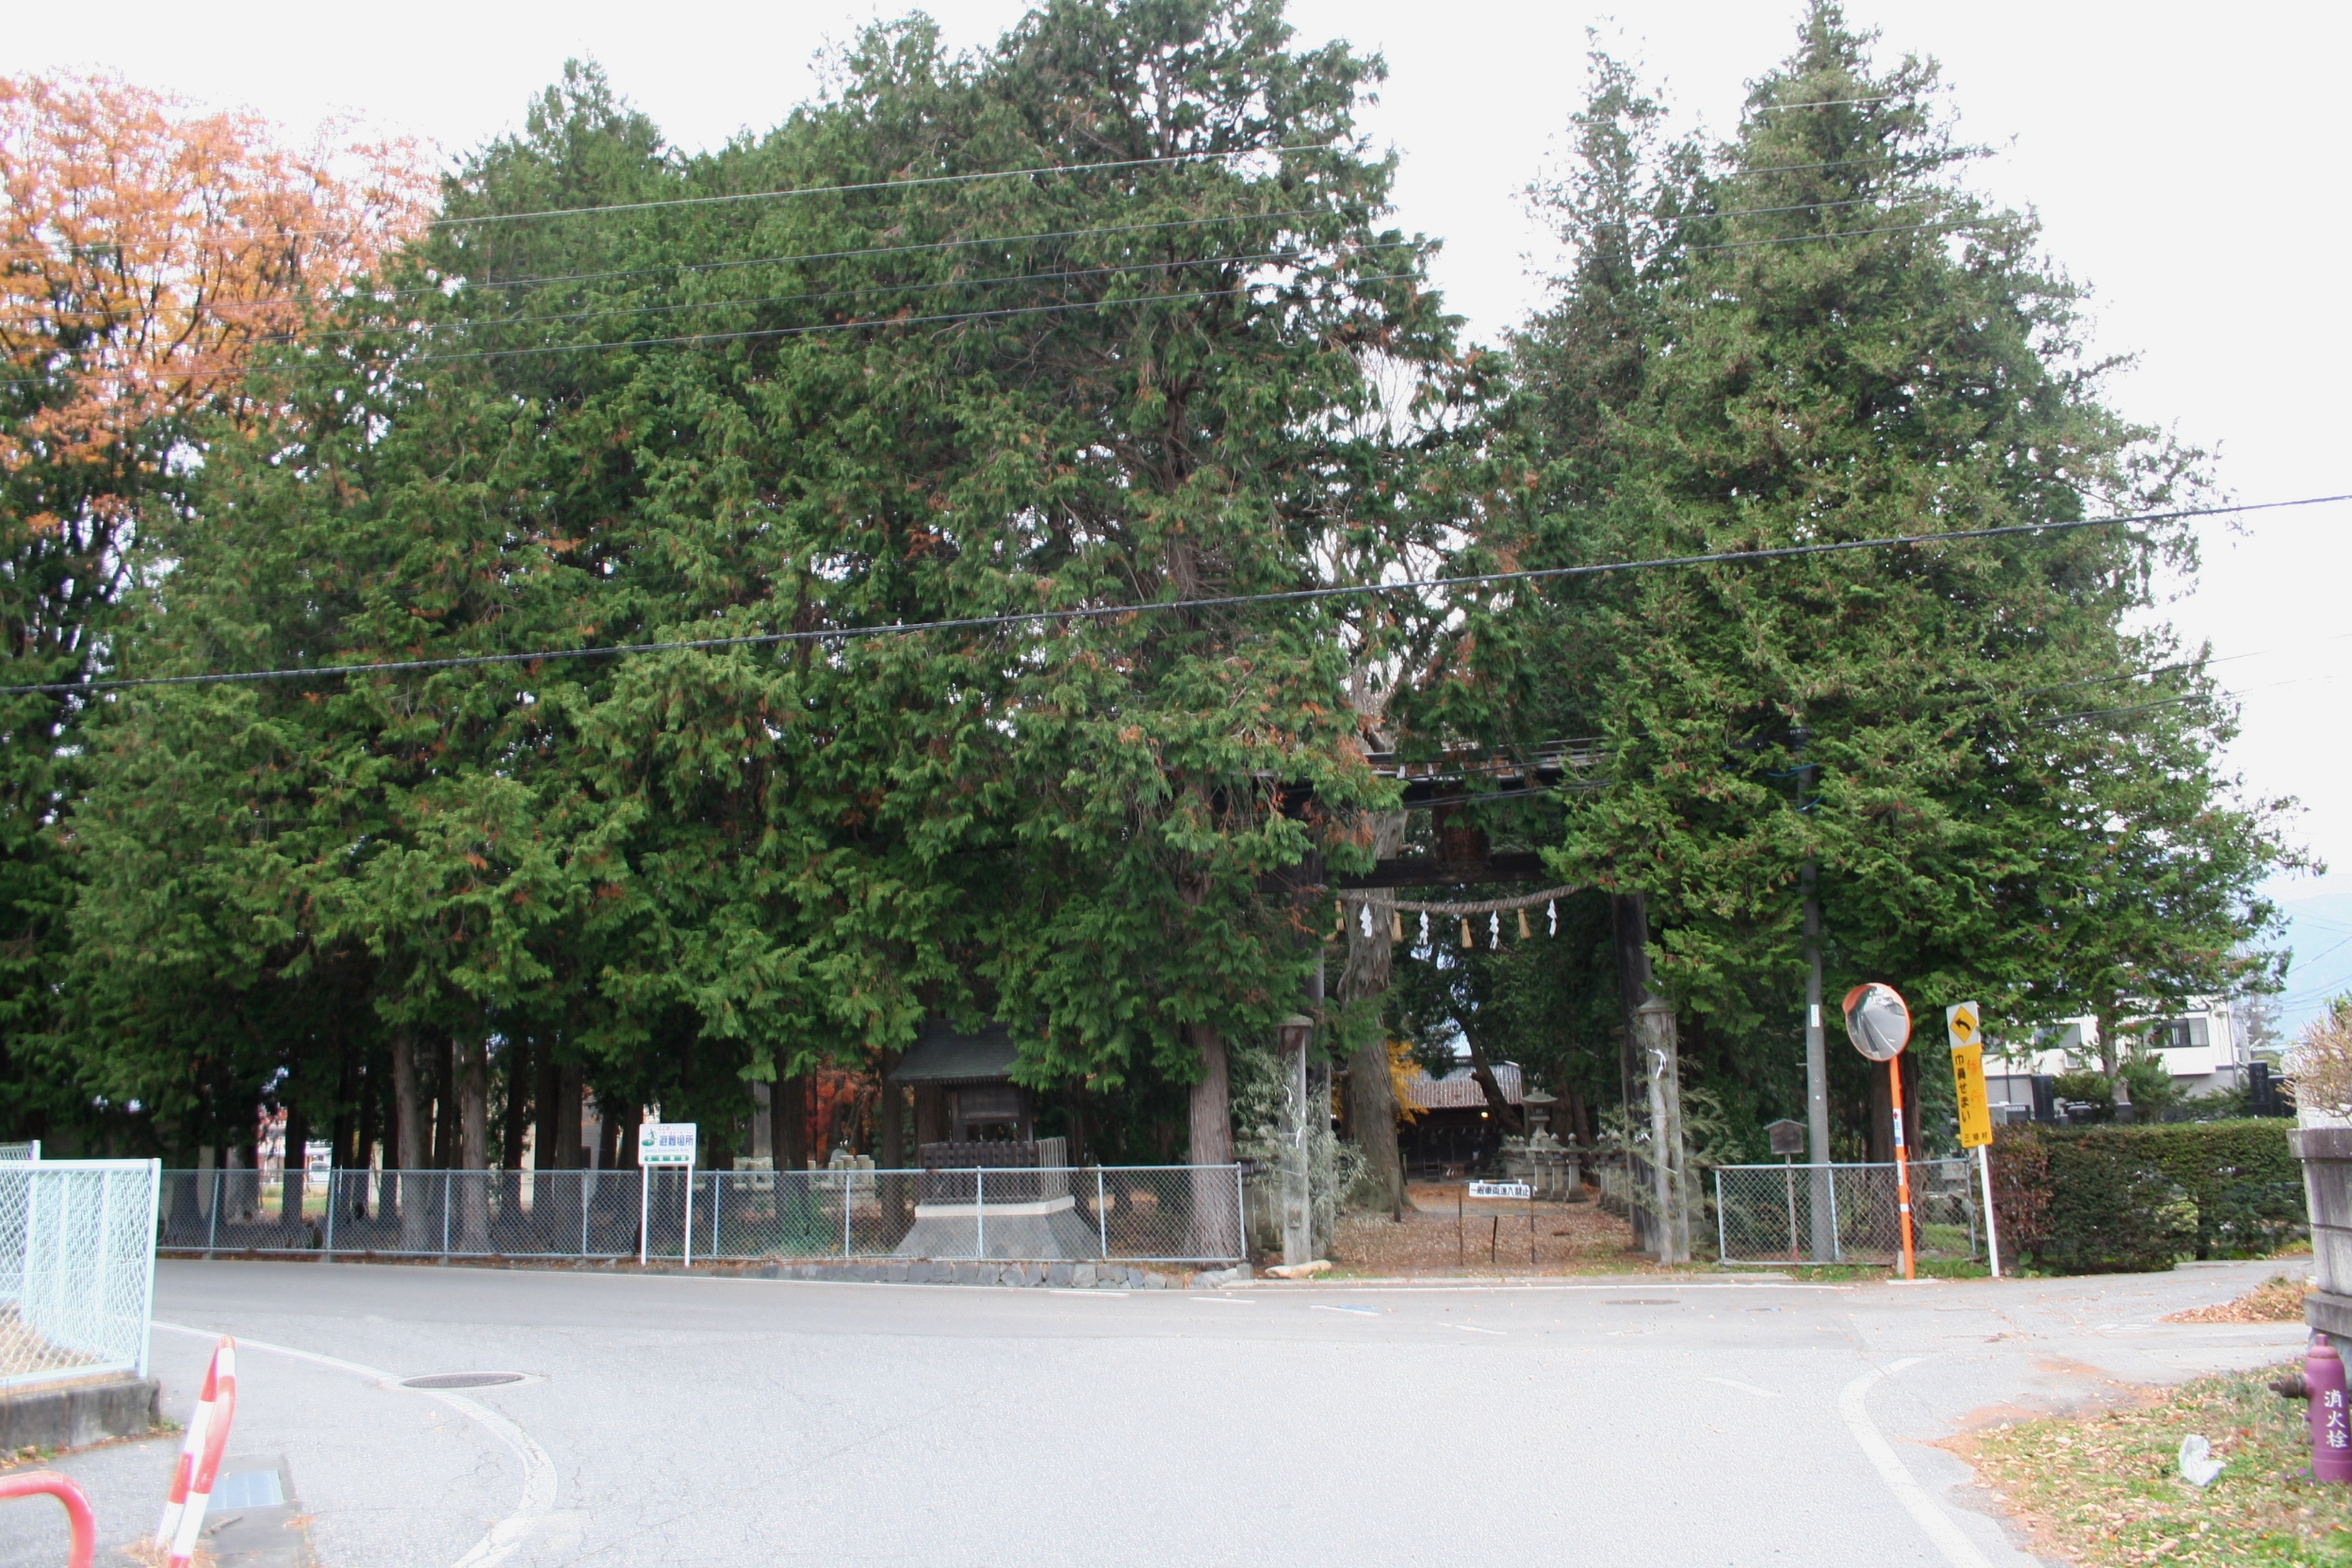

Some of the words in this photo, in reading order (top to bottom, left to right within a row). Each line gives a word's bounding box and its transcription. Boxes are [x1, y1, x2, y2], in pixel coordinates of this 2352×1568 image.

[660, 1135, 694, 1147] 避難場所
[1471, 1184, 1528, 1197] 一般車両進入禁止
[2324, 1389, 2348, 1447] 消火栓
